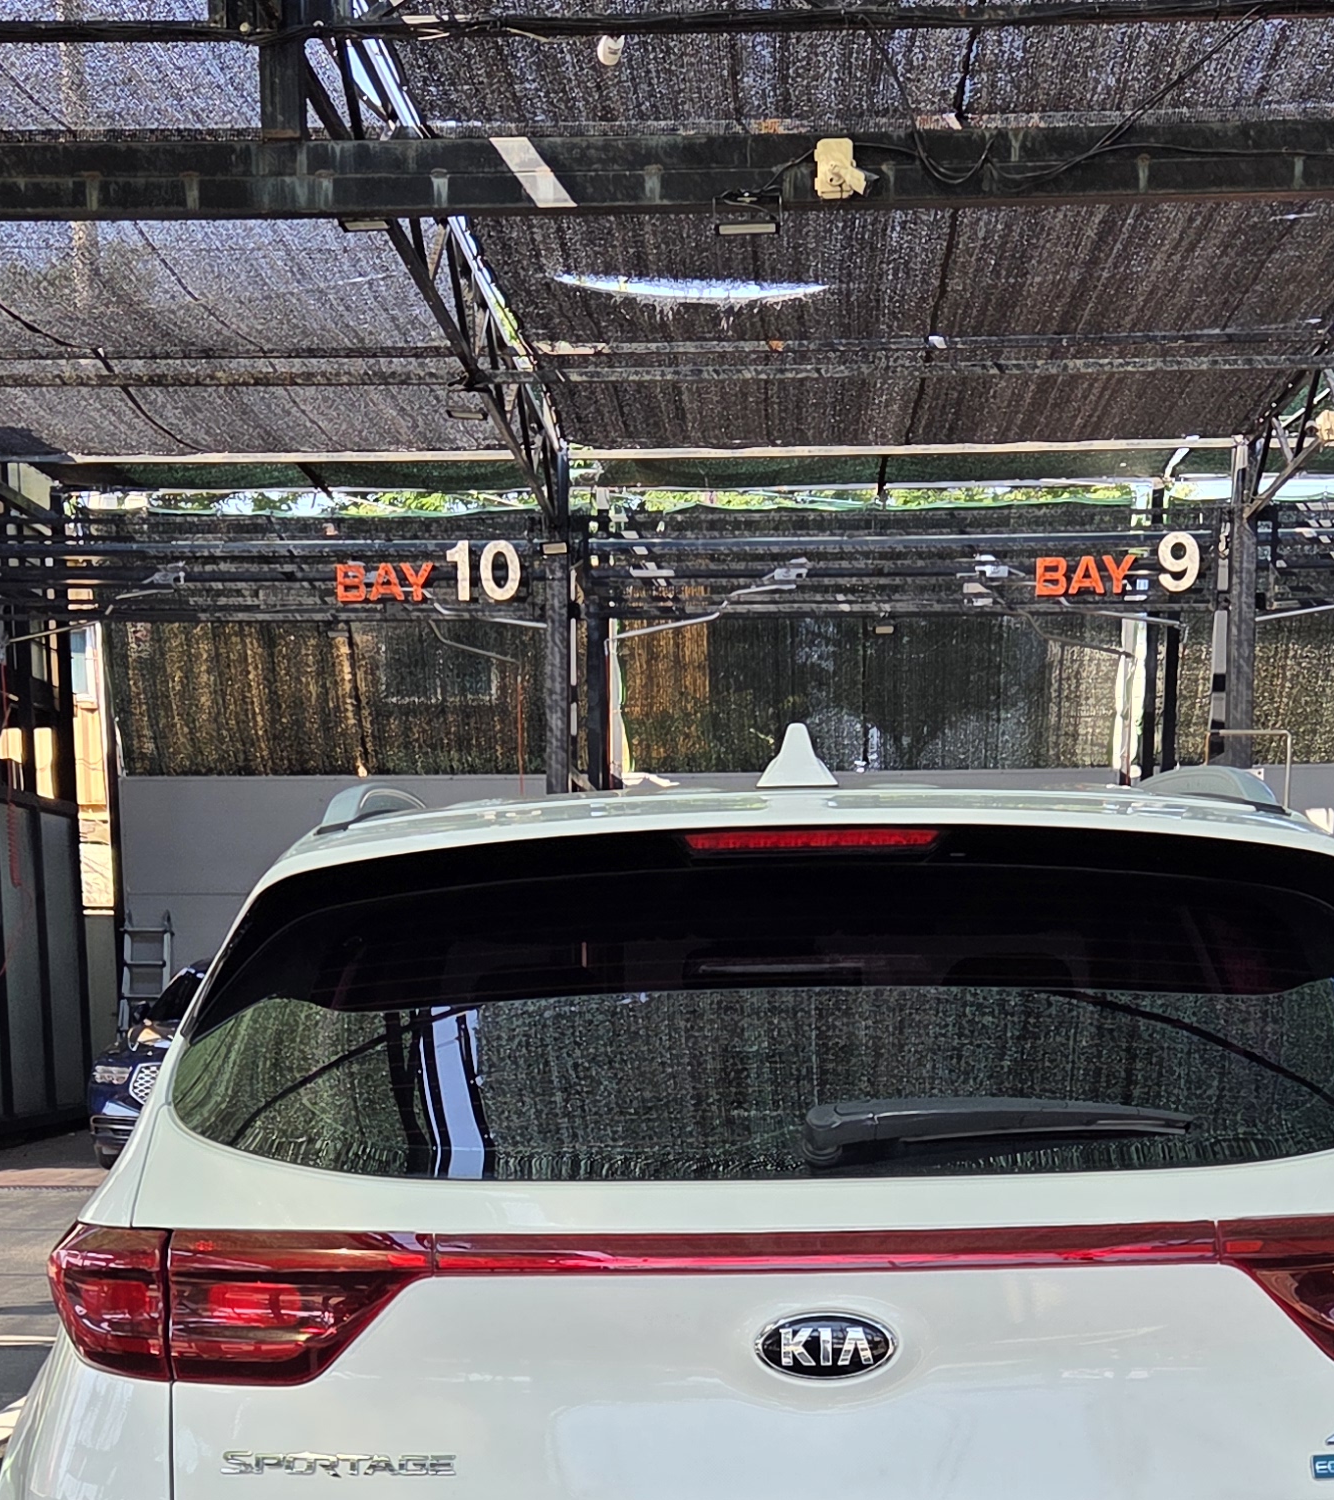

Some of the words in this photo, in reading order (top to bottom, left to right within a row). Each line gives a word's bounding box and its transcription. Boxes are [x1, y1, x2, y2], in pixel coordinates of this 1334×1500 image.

[337, 562, 433, 601] BAY
[446, 540, 521, 600] 10
[1035, 555, 1136, 595] BAY
[1158, 531, 1200, 592] 9
[779, 1327, 874, 1366] KIA
[220, 1450, 457, 1478] SPORTAGE
